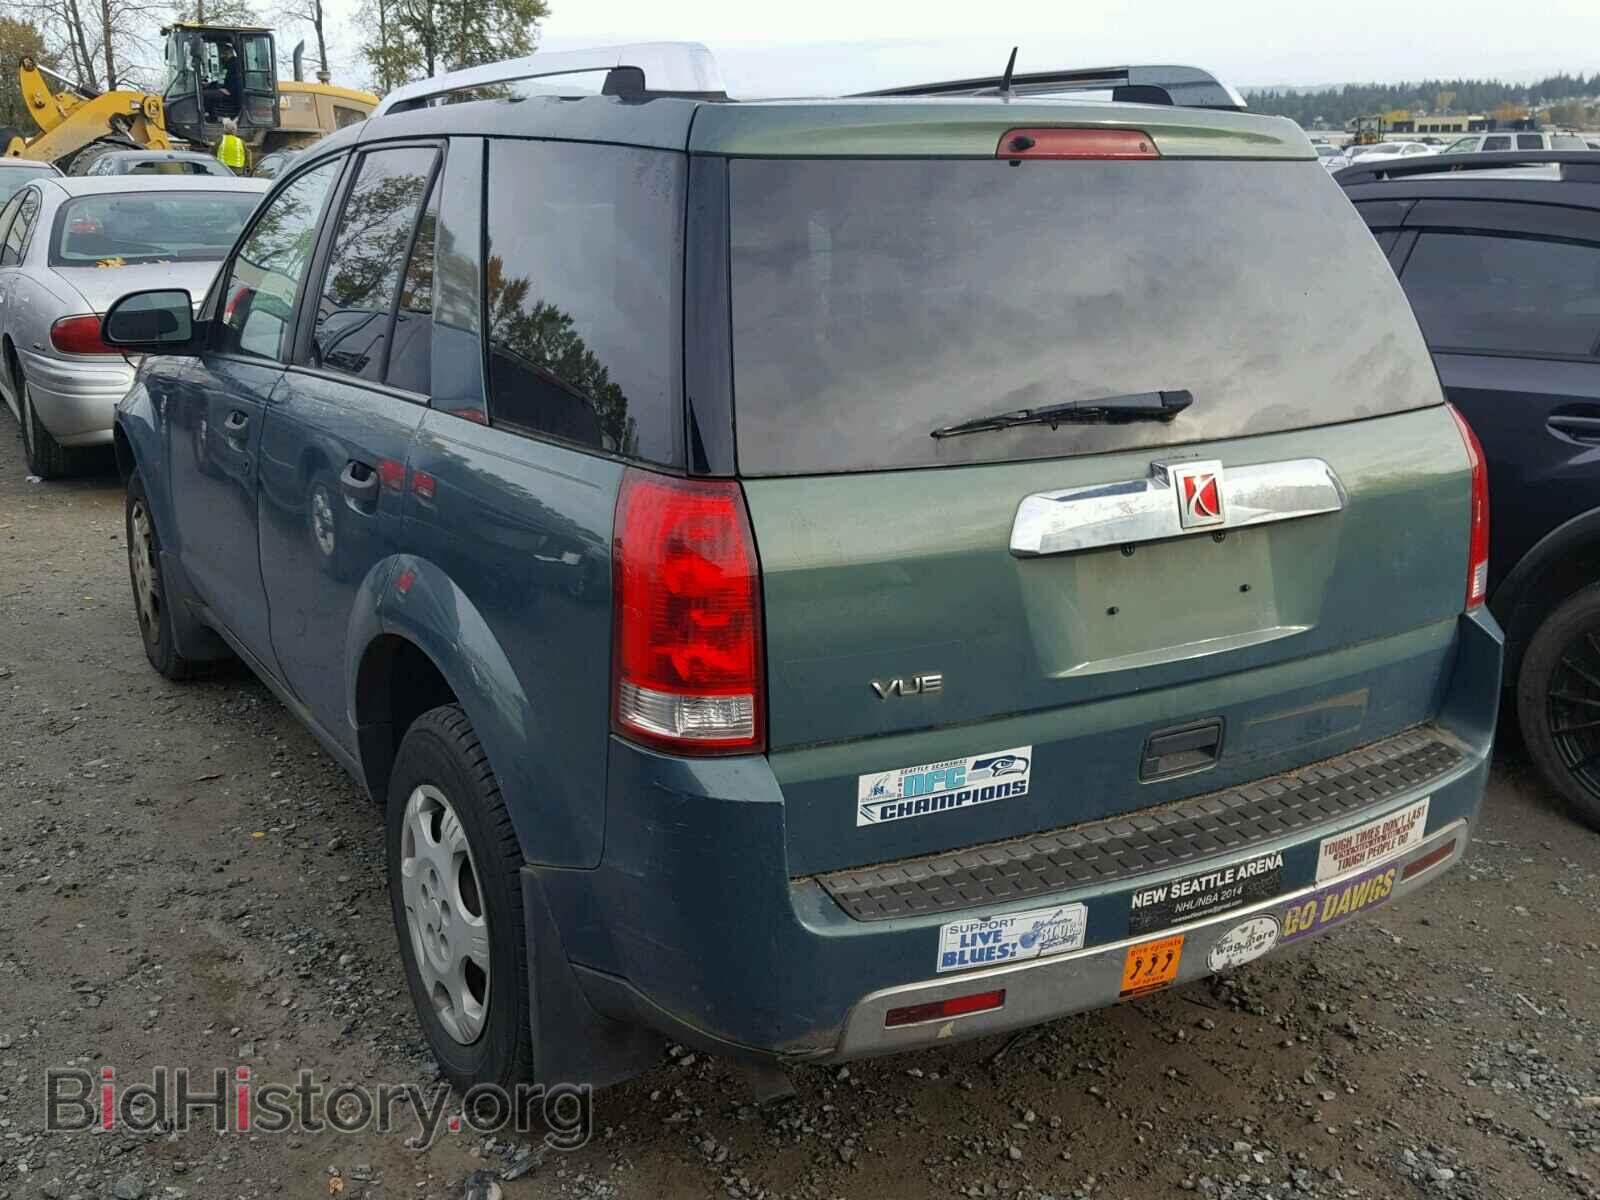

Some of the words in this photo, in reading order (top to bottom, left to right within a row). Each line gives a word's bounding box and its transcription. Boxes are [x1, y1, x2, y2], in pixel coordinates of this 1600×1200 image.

[870, 674, 943, 702] VUE
[900, 765, 929, 775] SEATTLE
[880, 780, 1027, 821] CHAMPIONS
[1324, 836, 1353, 857] TOUGH
[1356, 825, 1381, 843] TIMES
[1382, 815, 1405, 832] DON'T
[1408, 805, 1427, 824] LAST
[1338, 852, 1366, 871] TOUGH
[1367, 839, 1397, 859] PEOPLE
[1131, 888, 1168, 910] NEW
[1170, 868, 1235, 899] SEATTLE
[1235, 853, 1284, 881] ARENA
[1175, 891, 1219, 914] NHL/NBA
[1220, 886, 1244, 901] 2014
[1282, 900, 1317, 937] GO
[1320, 869, 1396, 923] DAWGS
[949, 918, 1017, 935] SUPPORT
[960, 930, 1003, 948] LIVE
[942, 942, 1018, 967] BLUES!
